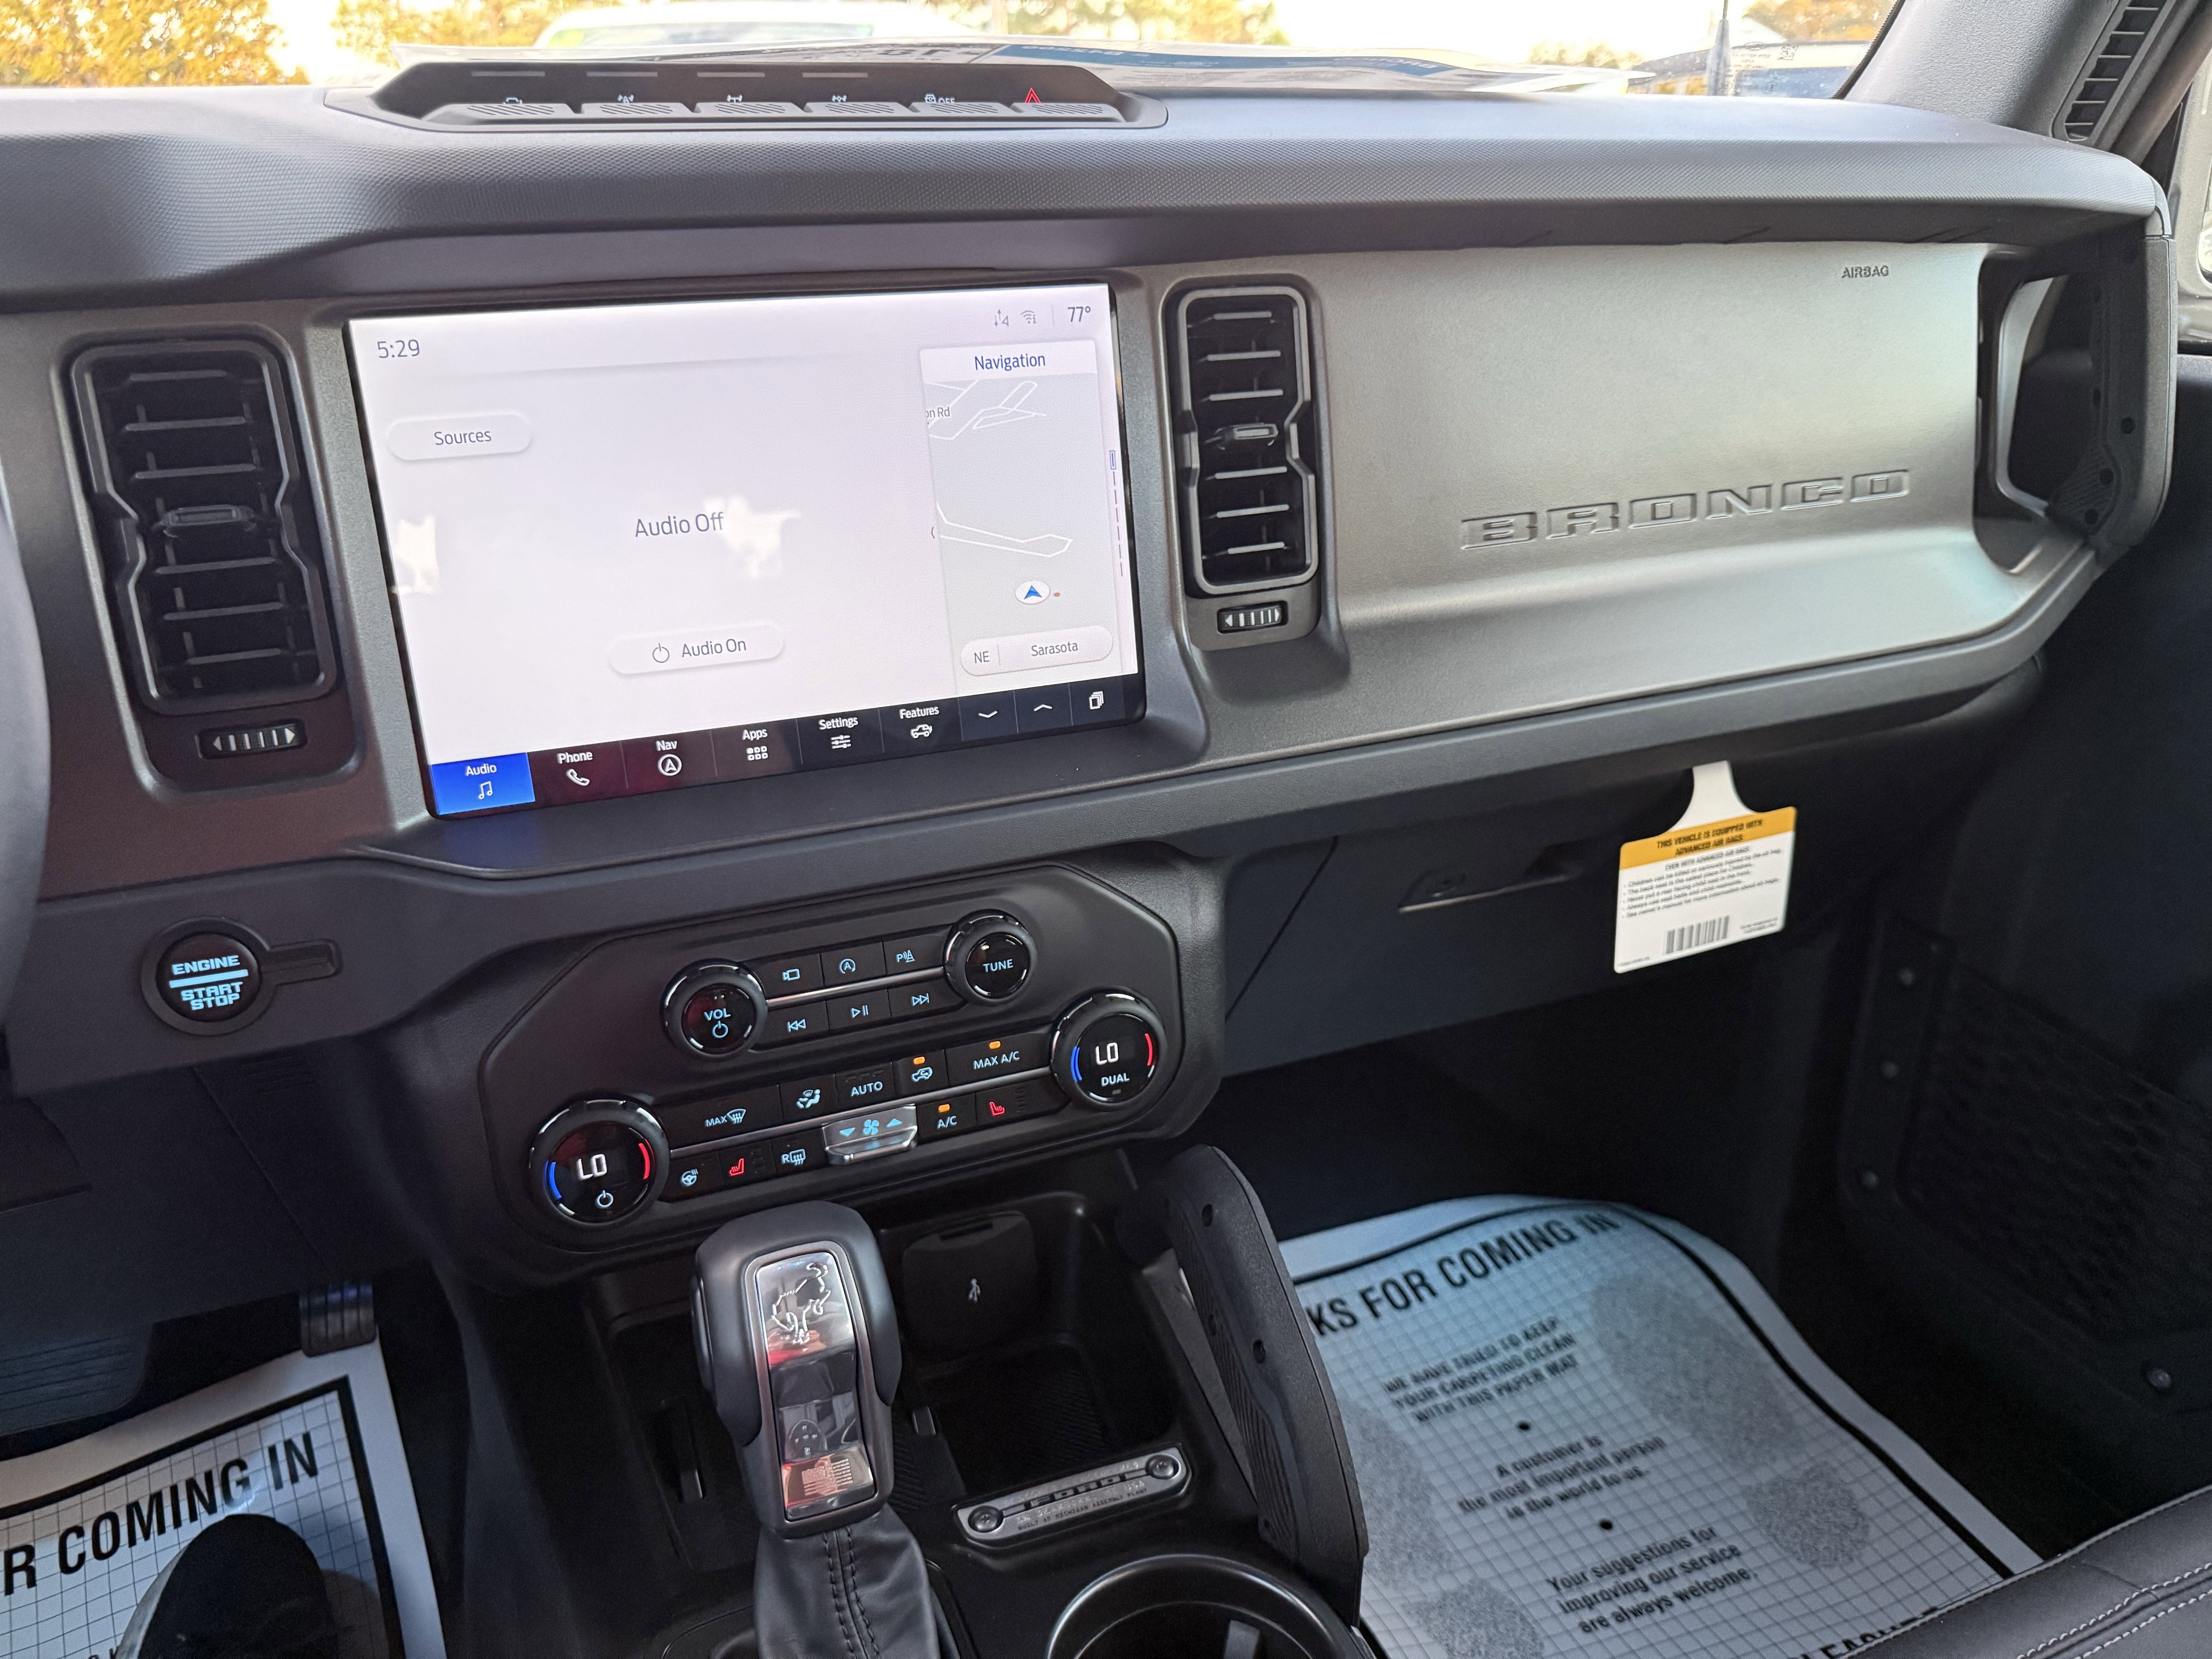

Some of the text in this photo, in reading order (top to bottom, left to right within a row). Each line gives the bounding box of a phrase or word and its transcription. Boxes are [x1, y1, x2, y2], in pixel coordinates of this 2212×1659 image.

[1842, 265, 1889, 278] AIRBAG
[377, 339, 420, 359] 5:29
[975, 354, 1046, 371] Navigation
[938, 407, 950, 417] Rd
[434, 430, 491, 446] Sources
[1461, 469, 1909, 550] BRONCO
[635, 512, 724, 538] Audio Off
[682, 638, 747, 657] Audio On
[1032, 641, 1078, 656] Sarasota
[974, 651, 990, 664] NE
[900, 706, 939, 720] Features
[819, 716, 859, 731] Settings
[742, 728, 768, 741] Apps
[656, 740, 677, 751] Nav
[558, 750, 592, 764] Phone
[466, 763, 497, 776] Audio
[1657, 838, 1673, 849] THIS
[1674, 832, 1702, 845] VEHICLE
[172, 955, 240, 975] ENGINE
[983, 959, 1013, 972] TUNE
[181, 982, 243, 1001] START
[190, 993, 240, 1010] STOP
[704, 1008, 731, 1021] VOL
[973, 1051, 1020, 1070] MAX A/C
[1095, 1042, 1119, 1066] LO
[1101, 1073, 1130, 1087] DUAL
[851, 1081, 883, 1096] AUTO
[705, 1115, 727, 1127] MAX
[937, 1116, 957, 1129] A/C
[577, 1154, 607, 1180] LO
[1360, 1270, 1437, 1319] FOR
[1439, 1219, 1577, 1289] COMING
[1574, 1213, 1621, 1235] IN
[59, 1458, 252, 1575] COMING
[268, 1431, 318, 1490] IN
[1547, 1524, 1717, 1593] Your suggestions for
[1648, 1566, 1678, 1584] our
[1679, 1542, 1741, 1572] service
